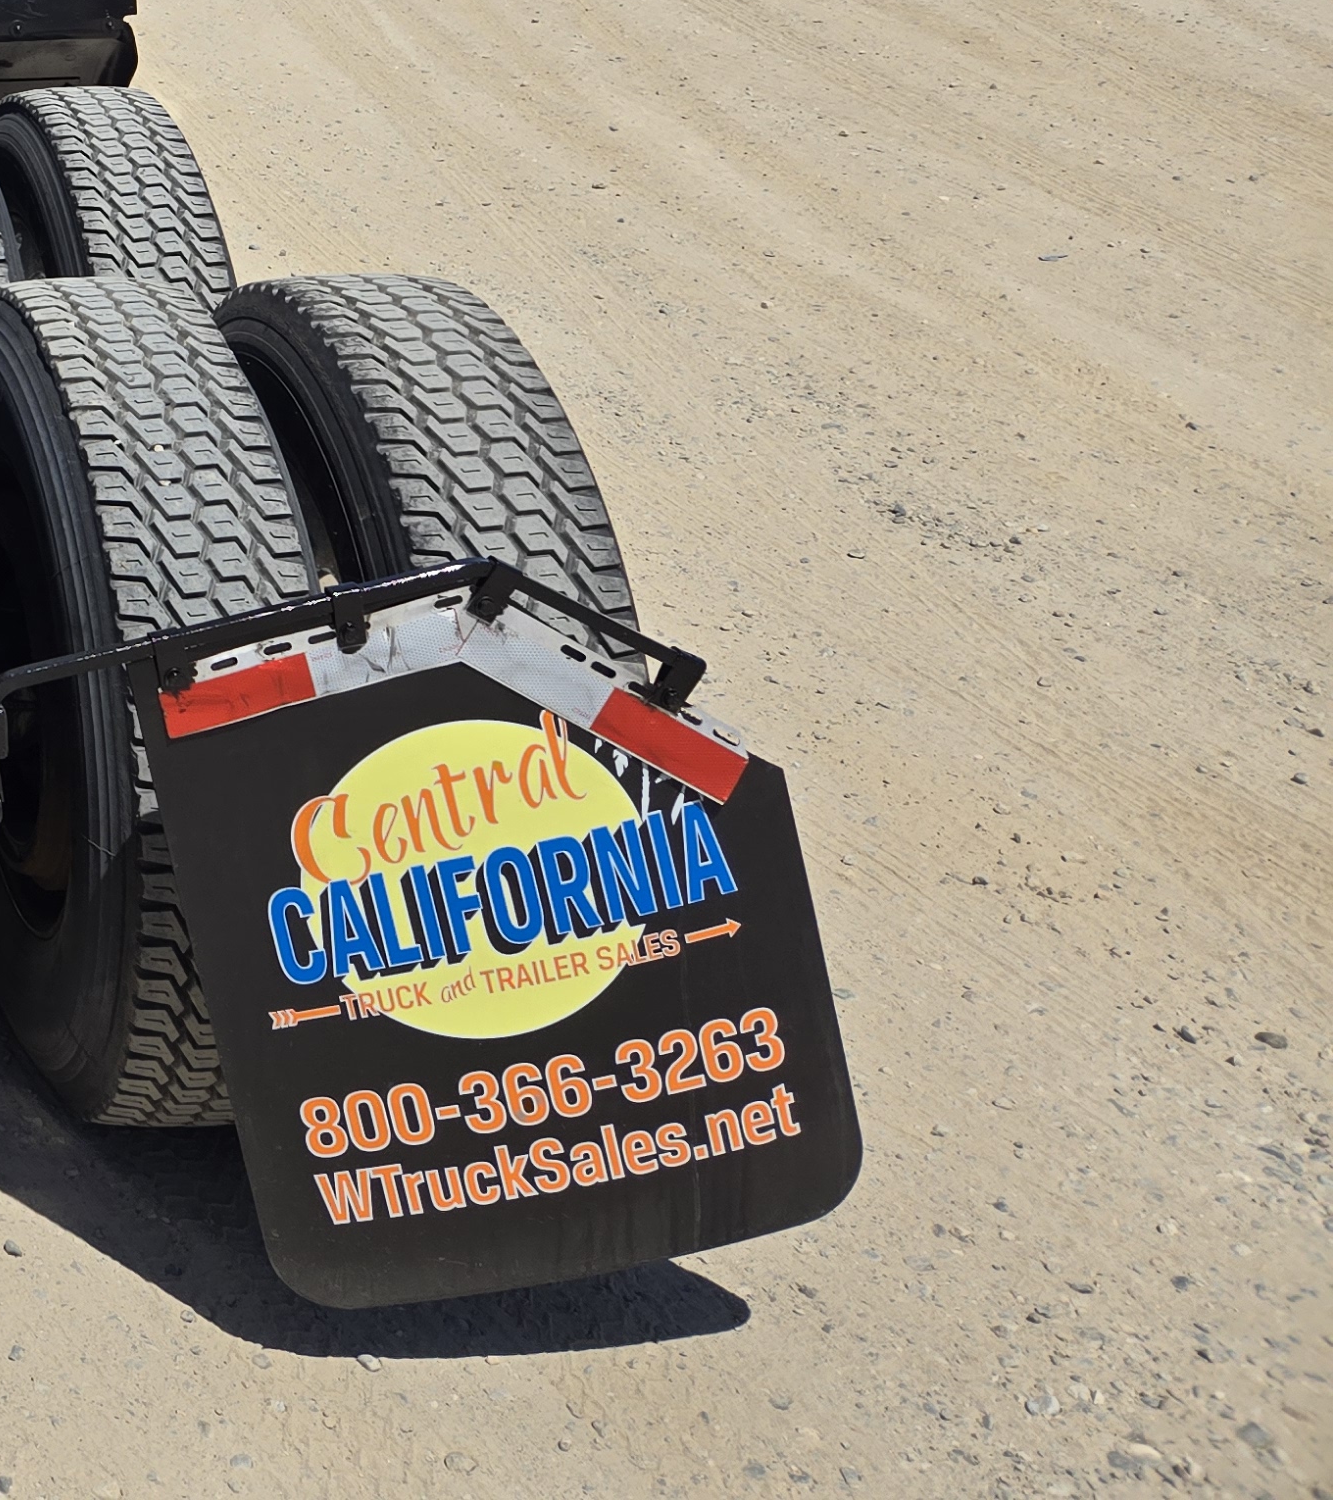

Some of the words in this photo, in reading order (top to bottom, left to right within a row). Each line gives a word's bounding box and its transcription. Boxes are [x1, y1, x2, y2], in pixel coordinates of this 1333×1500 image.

[291, 709, 587, 888] Central
[268, 801, 737, 985] CALIFORNIA
[340, 984, 432, 1022] TRUCK
[440, 969, 477, 1005] and
[479, 952, 591, 996] TRAILER
[597, 928, 681, 973] SALES
[299, 1007, 786, 1159] 800-366-3263
[313, 1083, 802, 1225] WTruckSales.net
